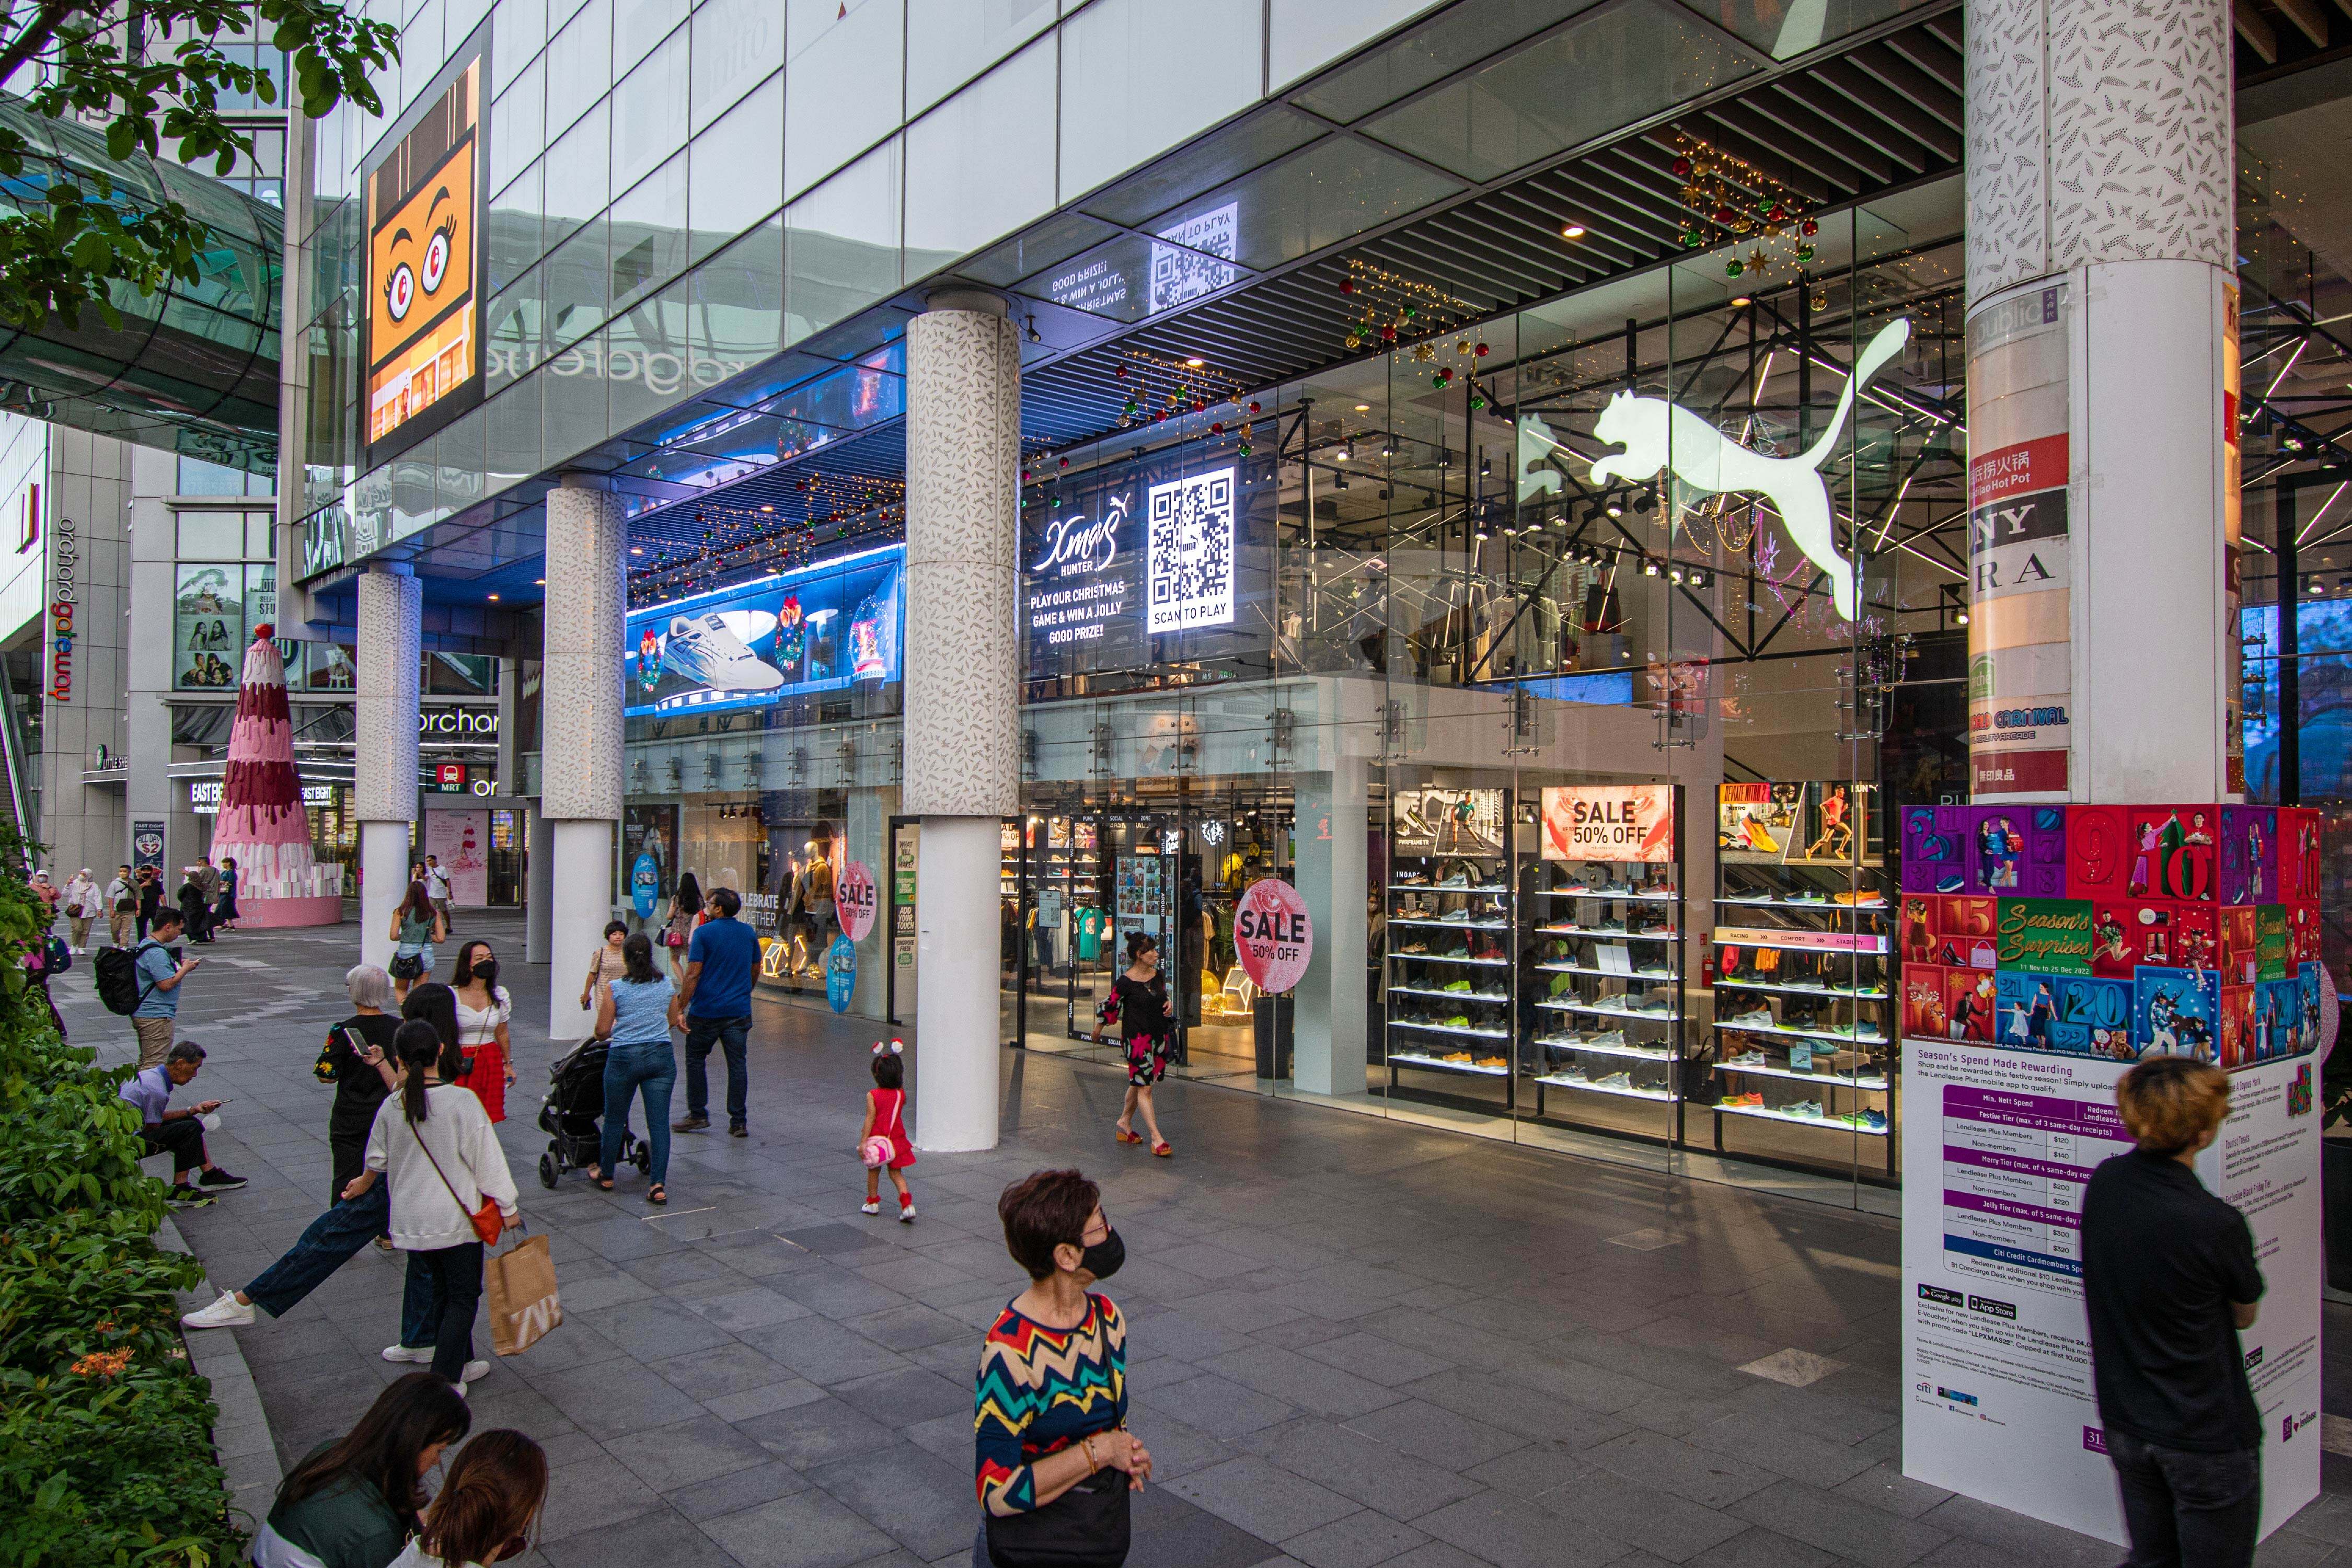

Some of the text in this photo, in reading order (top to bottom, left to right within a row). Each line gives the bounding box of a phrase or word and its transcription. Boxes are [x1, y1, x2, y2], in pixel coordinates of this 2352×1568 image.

[1992, 472, 2031, 490] Hot Pot
[1061, 561, 1092, 577] HUNTER
[1031, 581, 1124, 609] PLAY OUR CHRISTMAS
[48, 517, 79, 701] orchardgateway
[1033, 601, 1122, 627] GAME & WIN A JOLLY
[1155, 603, 1226, 624] SCAN TO PLAY
[1050, 624, 1103, 643] GOOD PRIZE!
[1969, 707, 2070, 731] ORLD CARNIVAL
[1999, 731, 2036, 741] ARCADE
[119, 757, 128, 769] SHE
[1979, 769, 2014, 782] 無印良品
[211, 783, 224, 801] EIG
[1725, 785, 1767, 802] DEVIATE NITRO 2
[1574, 801, 1635, 823] SALE
[139, 834, 160, 843] ALL DAY
[1574, 827, 1608, 843] 50%
[142, 843, 159, 854] $2
[839, 883, 873, 906] SALE
[845, 908, 870, 919] 50% OFF
[1947, 900, 1990, 935] 15
[1999, 905, 2090, 934] Season's
[897, 921, 914, 930] TOUCH
[1239, 910, 1305, 944] SALE
[1253, 945, 1299, 962] 50% OFF
[1997, 934, 2090, 961] Surprises
[2067, 981, 2127, 1026] 20
[1918, 1050, 2072, 1077] Season's Spend Made Rewarding
[1930, 1071, 1963, 1081] Lendlease
[1980, 1078, 2004, 1087] mobile
[2007, 1082, 2019, 1090] app
[2031, 1084, 2057, 1094] qualify.
[2014, 1099, 2033, 1108] Spend
[2088, 1106, 2113, 1115] Redeem
[1980, 1111, 2001, 1120] Festive
[2016, 1115, 2033, 1125] (max.
[2049, 1121, 2080, 1133] same-day
[2083, 1125, 2112, 1137] receipts)
[2084, 1113, 2117, 1124] Lendlease
[1957, 1123, 2032, 1140] Lendlease Plus Members
[1972, 1140, 2016, 1152] Non-members
[2054, 1136, 2069, 1144] $120
[2054, 1151, 2069, 1159] $140
[1982, 1156, 1999, 1165] Merry
[2001, 1158, 2012, 1167] Tier
[2014, 1161, 2030, 1170] (max.
[2047, 1166, 2078, 1178] same-day
[1973, 1185, 2016, 1198] Non-members
[2053, 1182, 2070, 1191] $200
[2053, 1198, 2069, 1206] $220
[1973, 1230, 2016, 1244] Non-members
[2053, 1229, 2070, 1238] $300
[2053, 1246, 2069, 1254] $320
[2007, 1251, 2026, 1261] Credit
[2027, 1255, 2069, 1270] Cardmembers
[1931, 1291, 1962, 1305] Google play
[1980, 1303, 2013, 1317] App Store
[1917, 1383, 1931, 1394] citi
